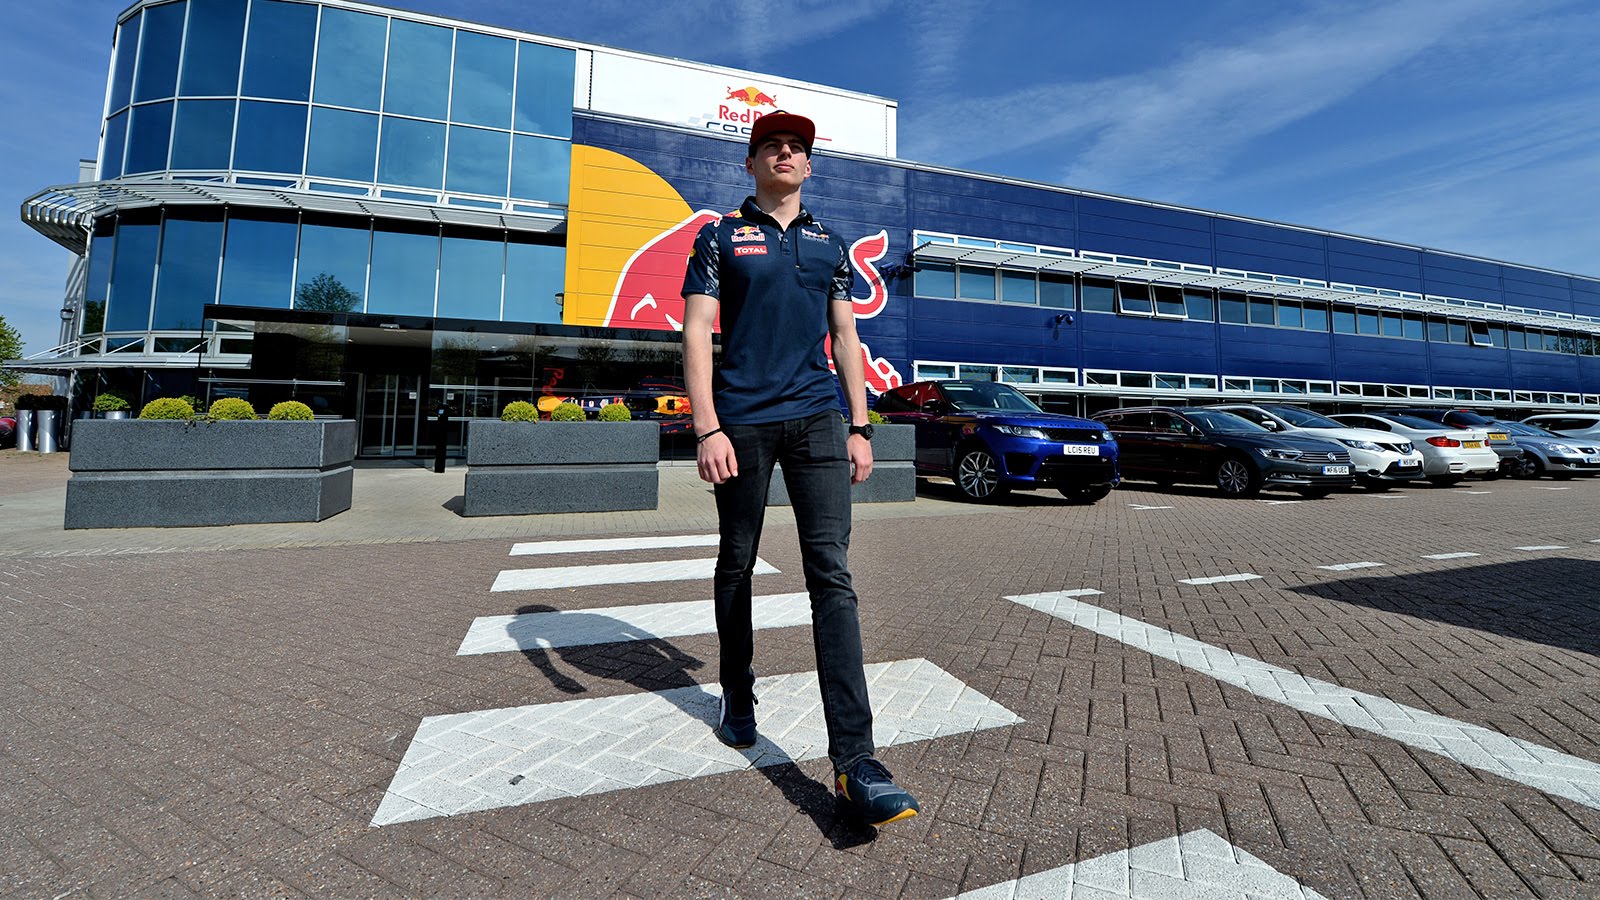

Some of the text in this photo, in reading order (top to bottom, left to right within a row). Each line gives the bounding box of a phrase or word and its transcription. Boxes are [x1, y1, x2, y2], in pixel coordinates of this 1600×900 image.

[719, 104, 750, 124] Red
[731, 234, 748, 242] Red
[1067, 446, 1082, 454] LC15
